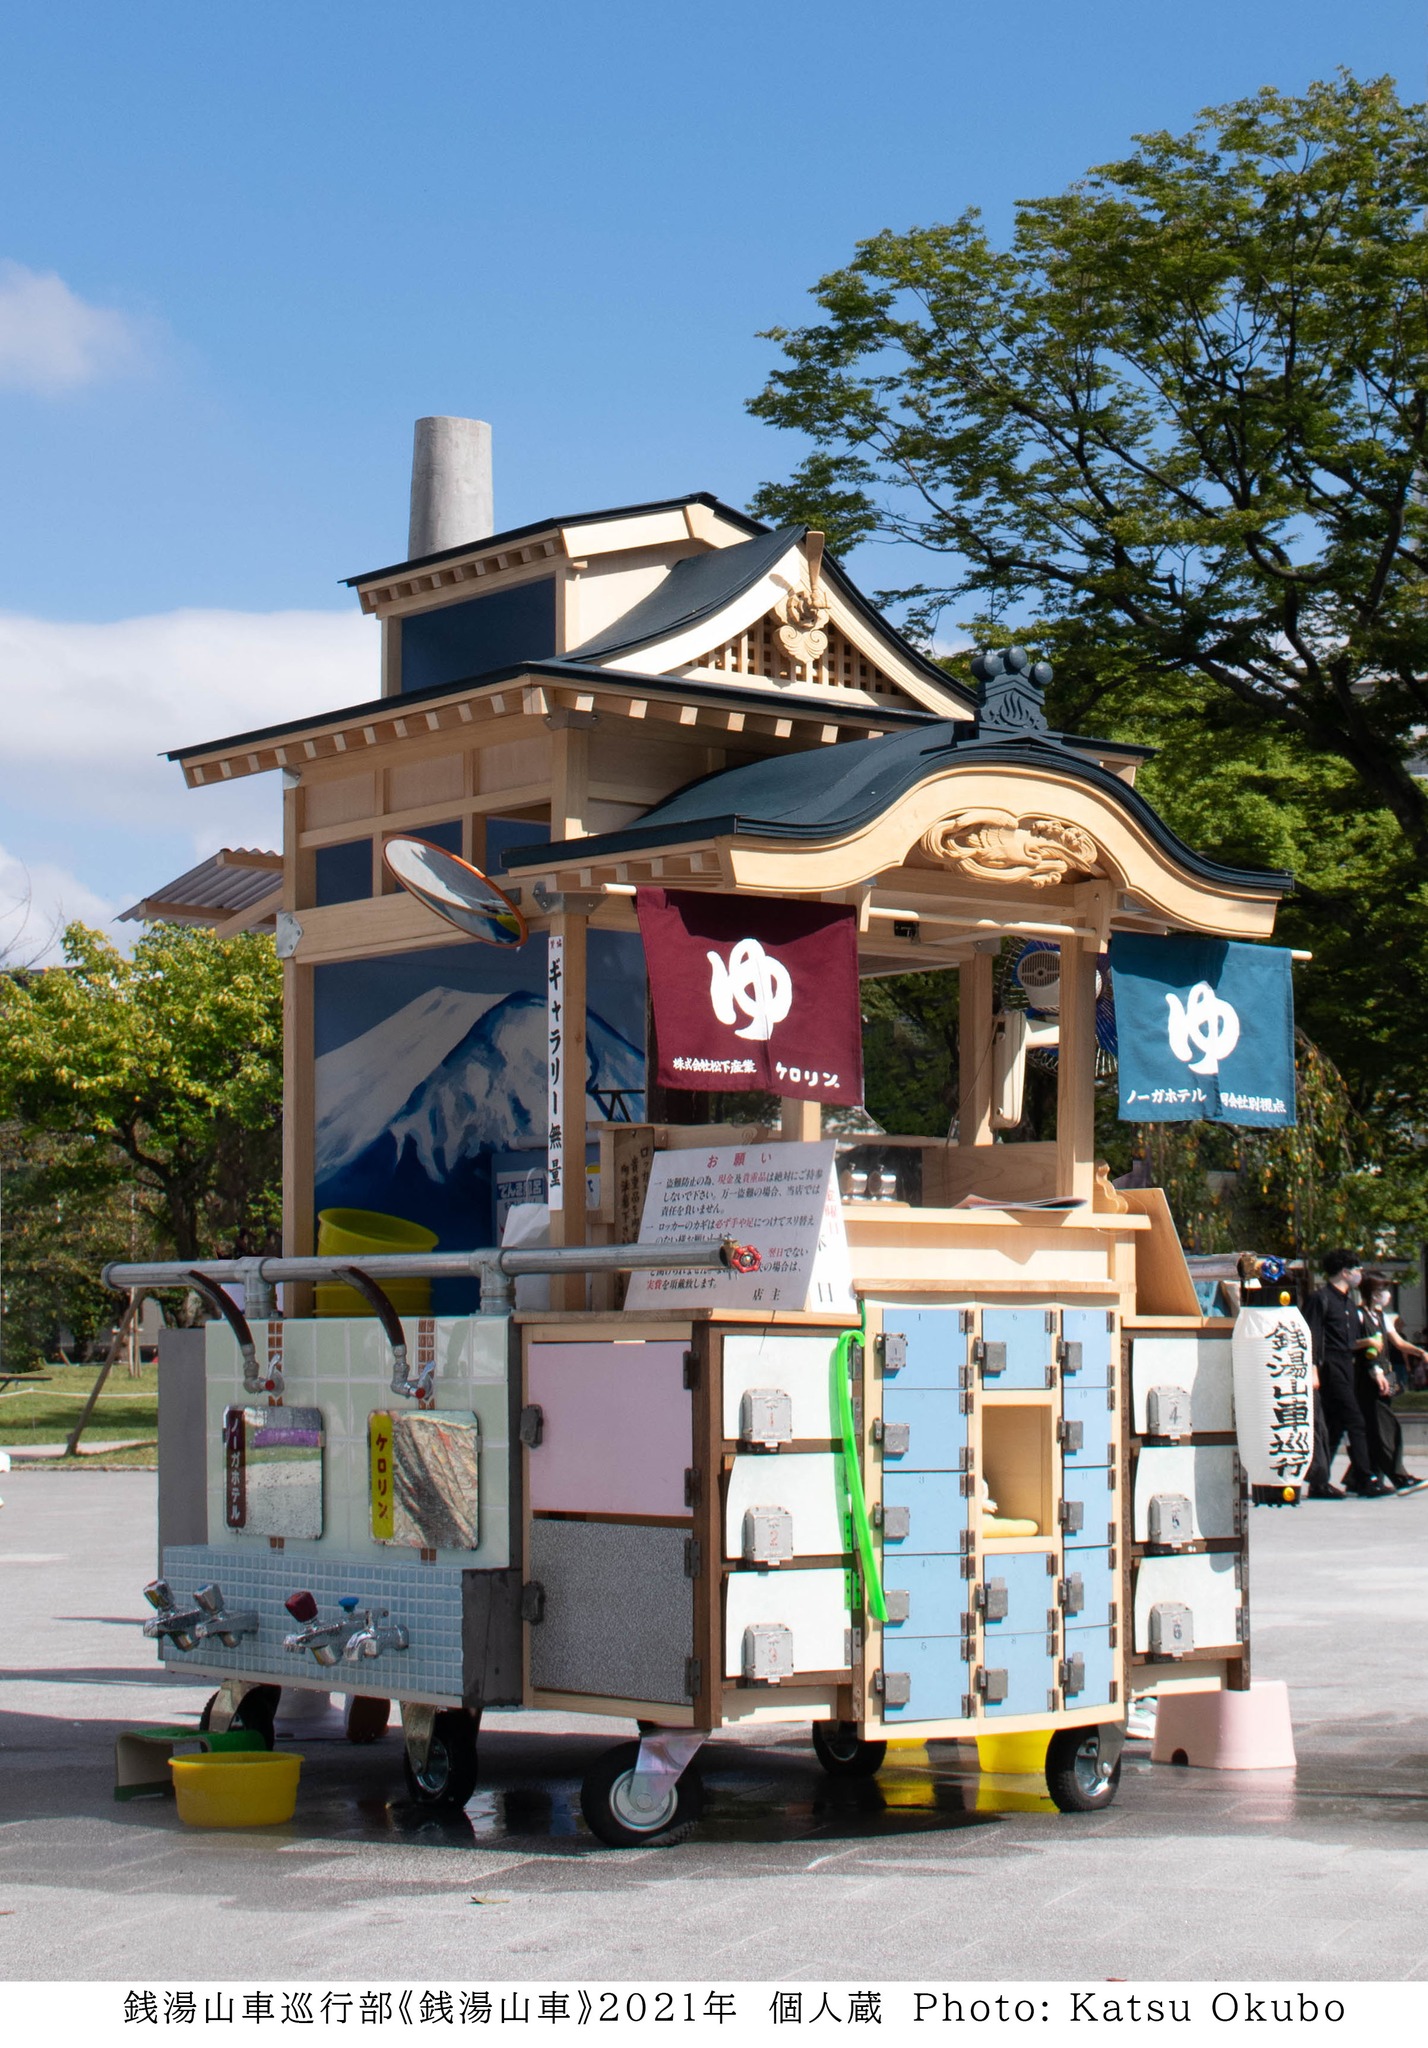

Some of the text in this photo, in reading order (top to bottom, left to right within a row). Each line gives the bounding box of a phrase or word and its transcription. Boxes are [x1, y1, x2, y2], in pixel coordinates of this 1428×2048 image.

[706, 937, 793, 1041] ゆ
[1165, 980, 1240, 1075] ゆ
[549, 958, 563, 1188] ギャラリー無量
[672, 1056, 757, 1074] 株式会社松下産業
[1126, 1087, 1208, 1104] ノーガホテル
[706, 1152, 773, 1169] お願い
[661, 1203, 725, 1217] 責任を負いません。
[1265, 1320, 1310, 1478] 銭湯山車巡行
[229, 1418, 241, 1521] ノーガホテル
